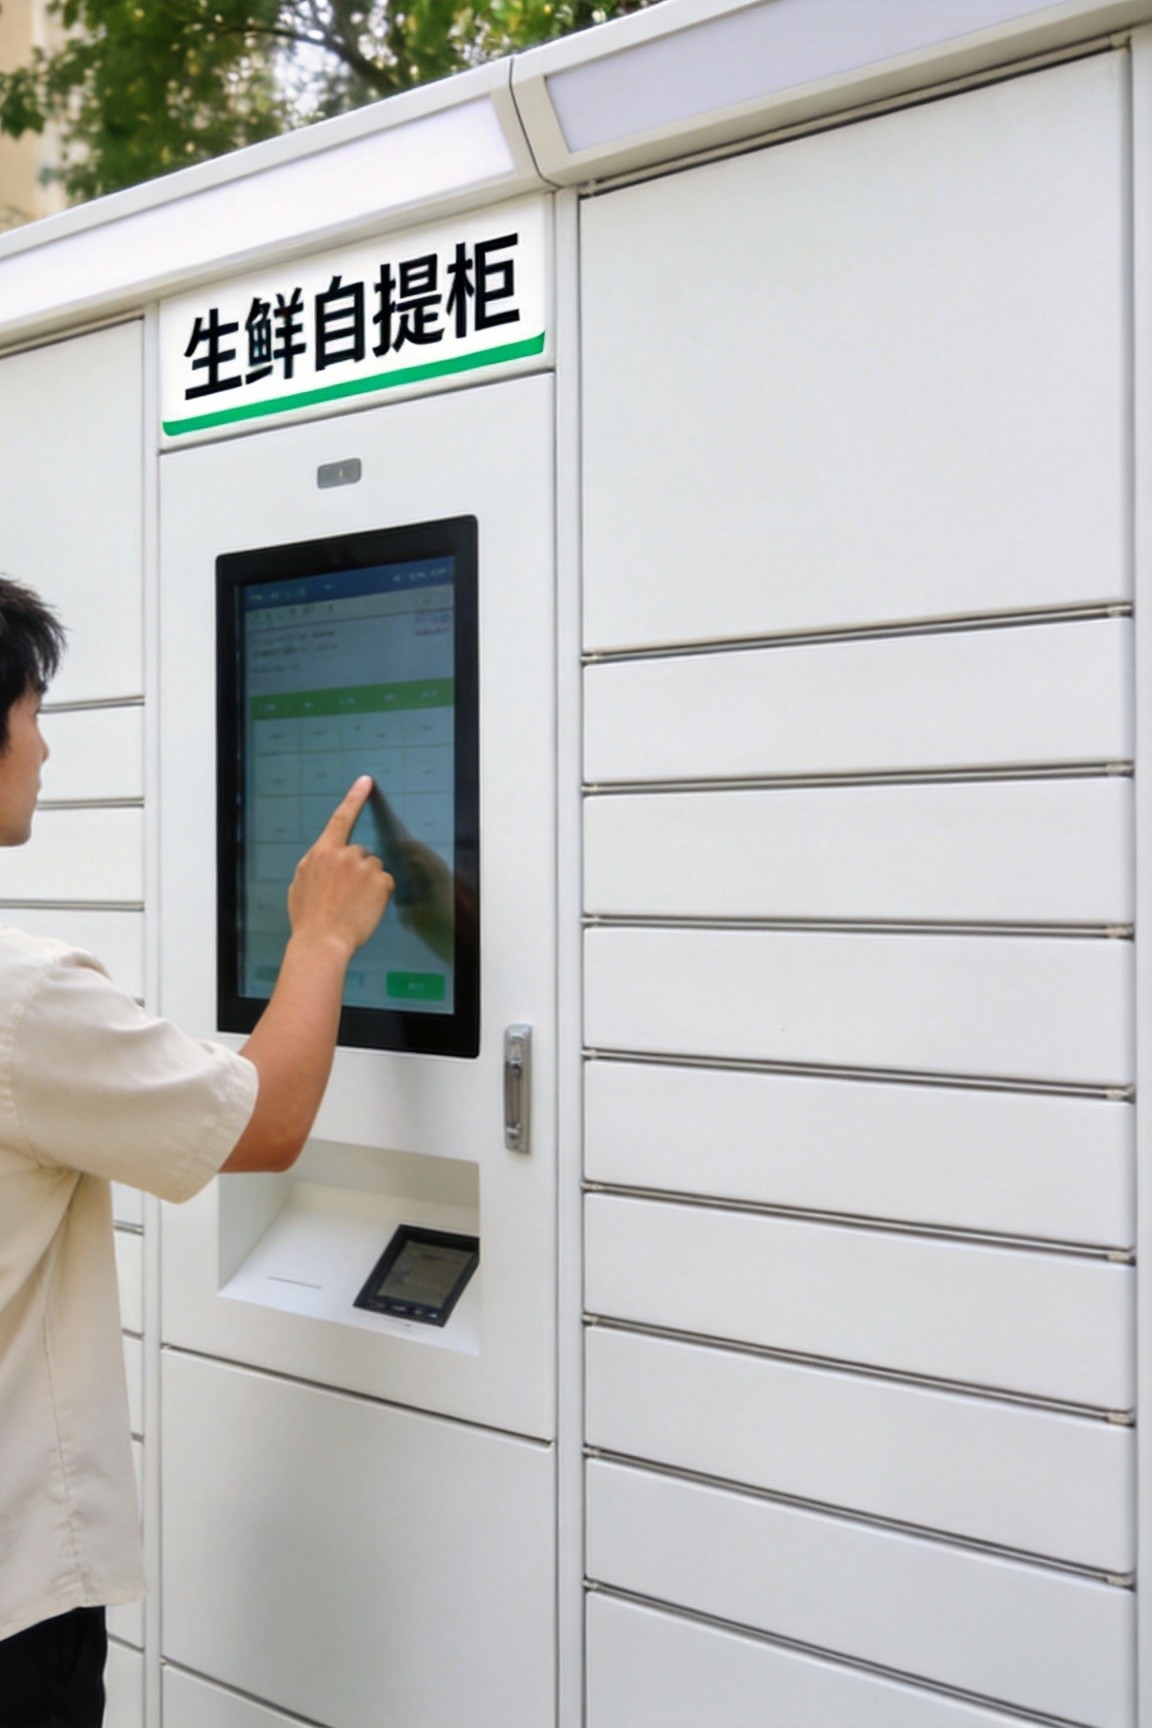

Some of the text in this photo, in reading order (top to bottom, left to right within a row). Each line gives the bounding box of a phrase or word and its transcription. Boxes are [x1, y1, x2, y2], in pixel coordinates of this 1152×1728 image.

[184, 233, 520, 400] 生鲜自提柜
